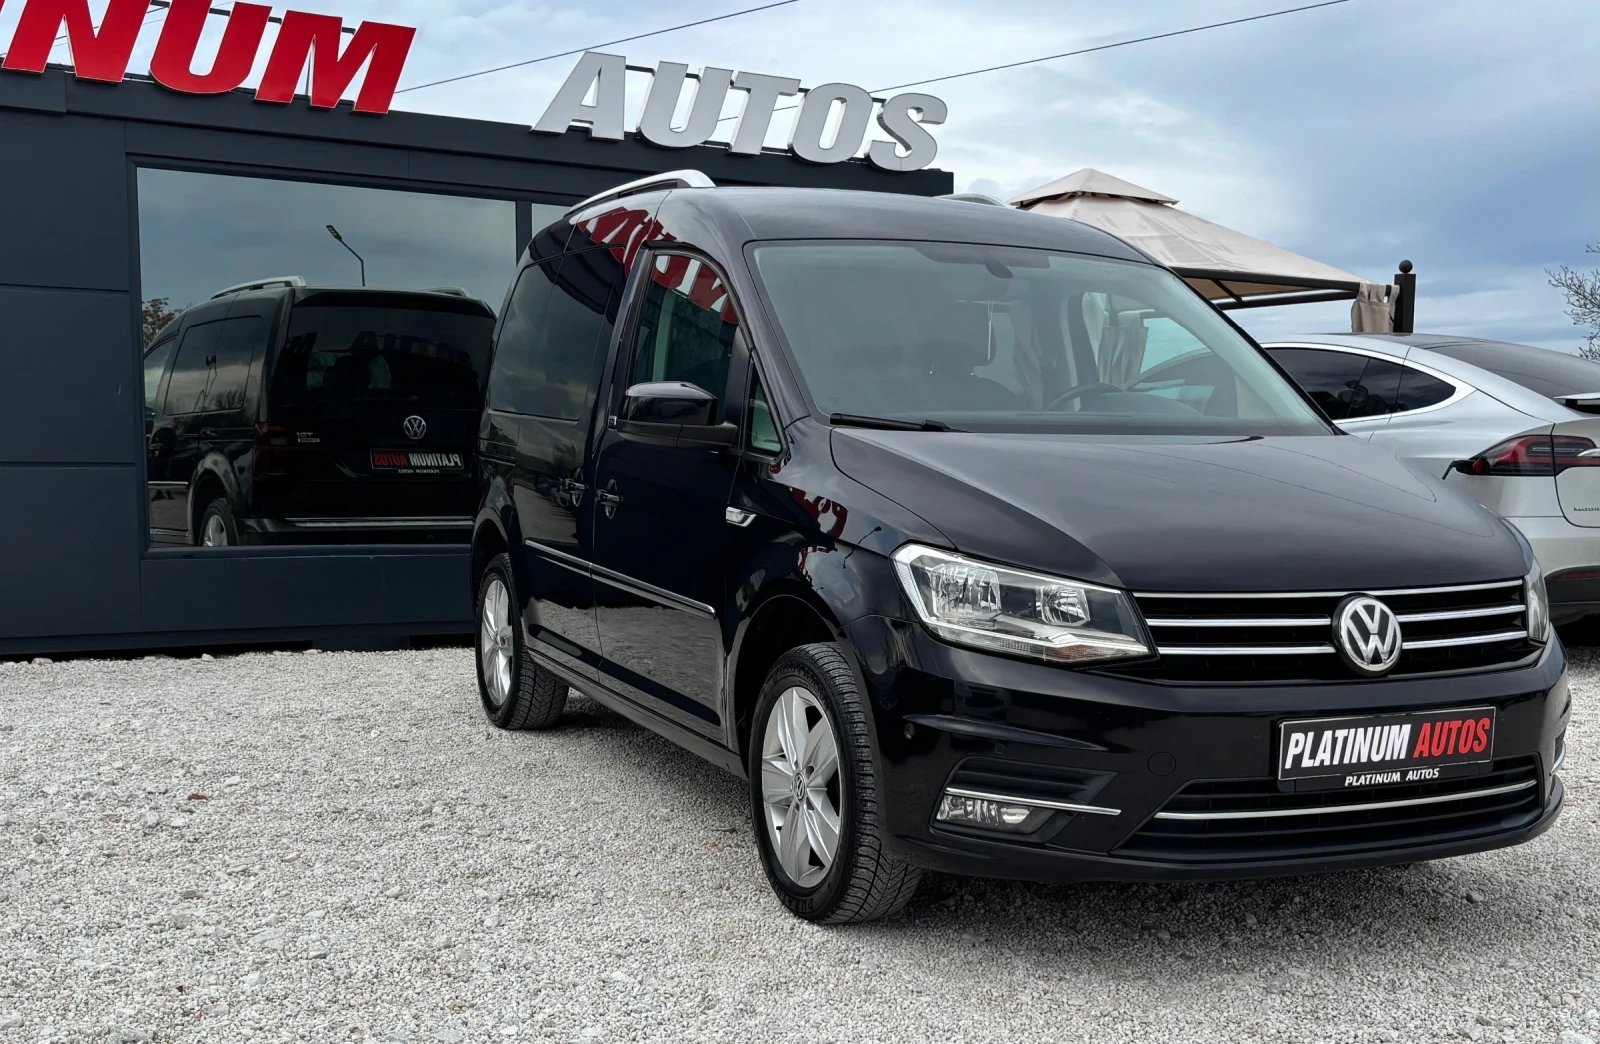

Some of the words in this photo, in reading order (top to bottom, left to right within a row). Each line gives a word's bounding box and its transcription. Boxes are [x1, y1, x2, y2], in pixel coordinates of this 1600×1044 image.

[0, 0, 416, 114] NUM
[530, 50, 948, 172] AUTOS
[1284, 723, 1412, 769] PLATINUM
[1413, 717, 1491, 758] AUTOS
[1344, 771, 1401, 787] PLATINUM
[1405, 767, 1440, 781] AUTOS
